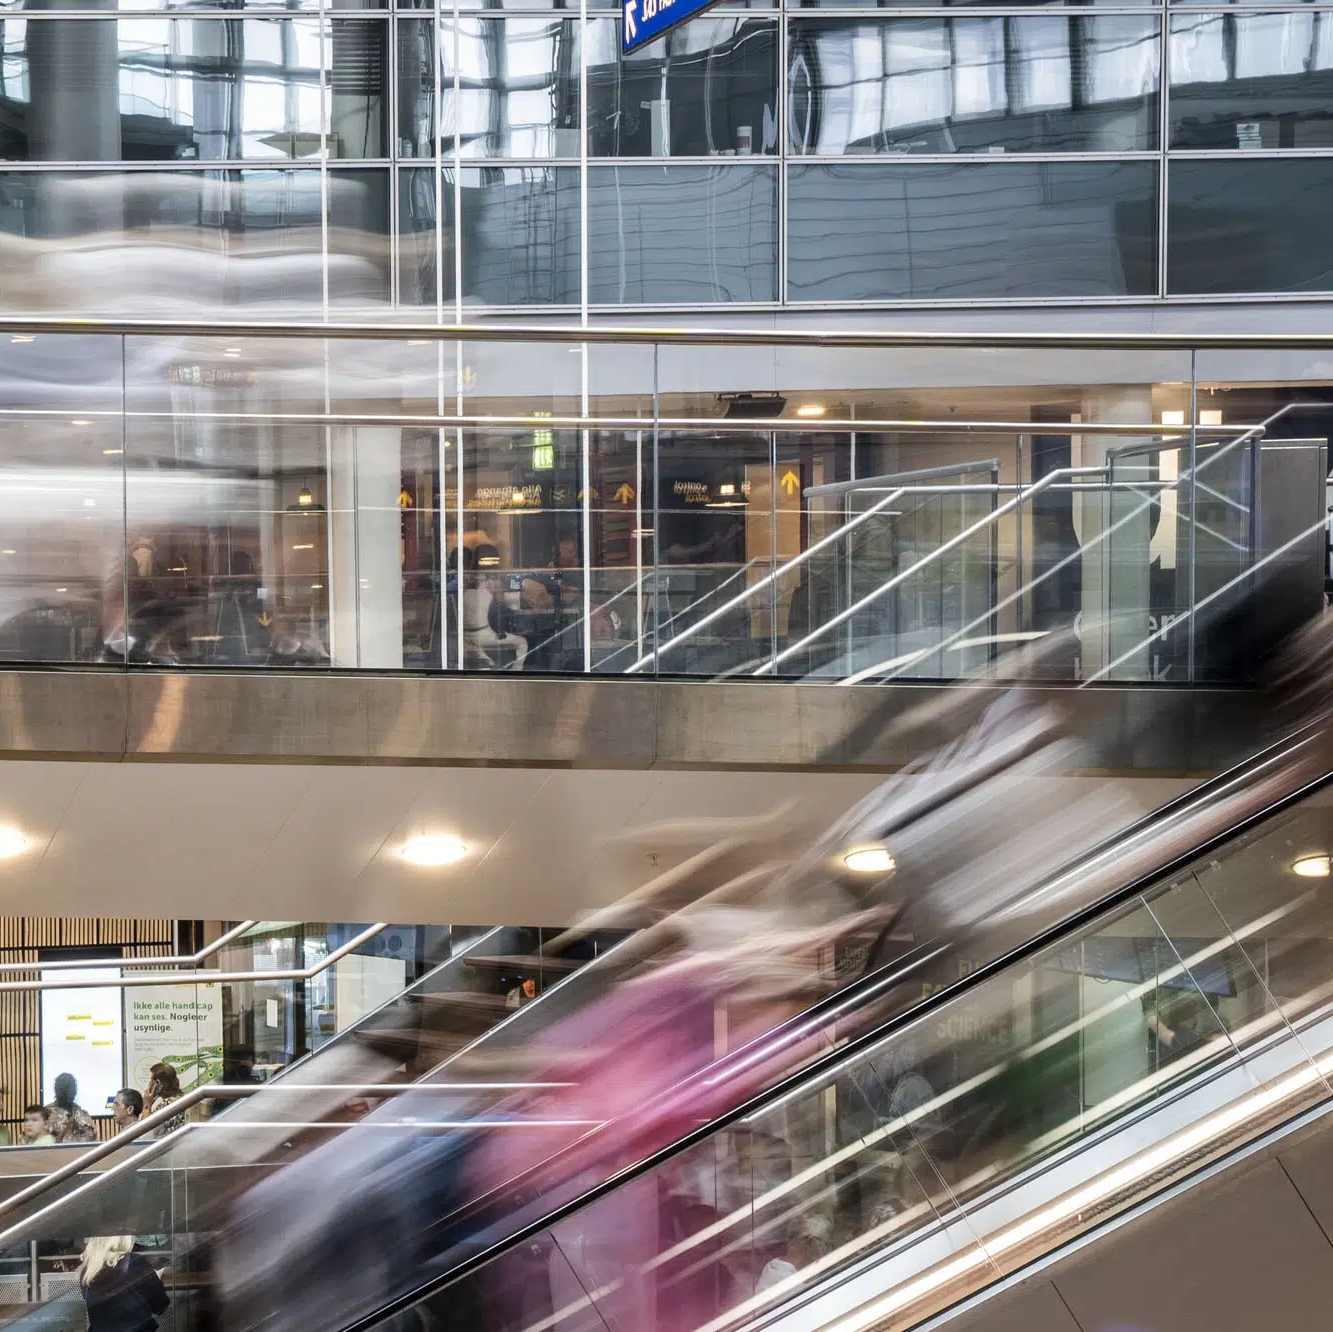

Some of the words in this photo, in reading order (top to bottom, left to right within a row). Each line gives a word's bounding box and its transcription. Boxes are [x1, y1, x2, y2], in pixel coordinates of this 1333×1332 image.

[172, 1001, 213, 1012] handcap
[170, 1013, 198, 1022] Nogle
[134, 1024, 173, 1033] usynlige.
